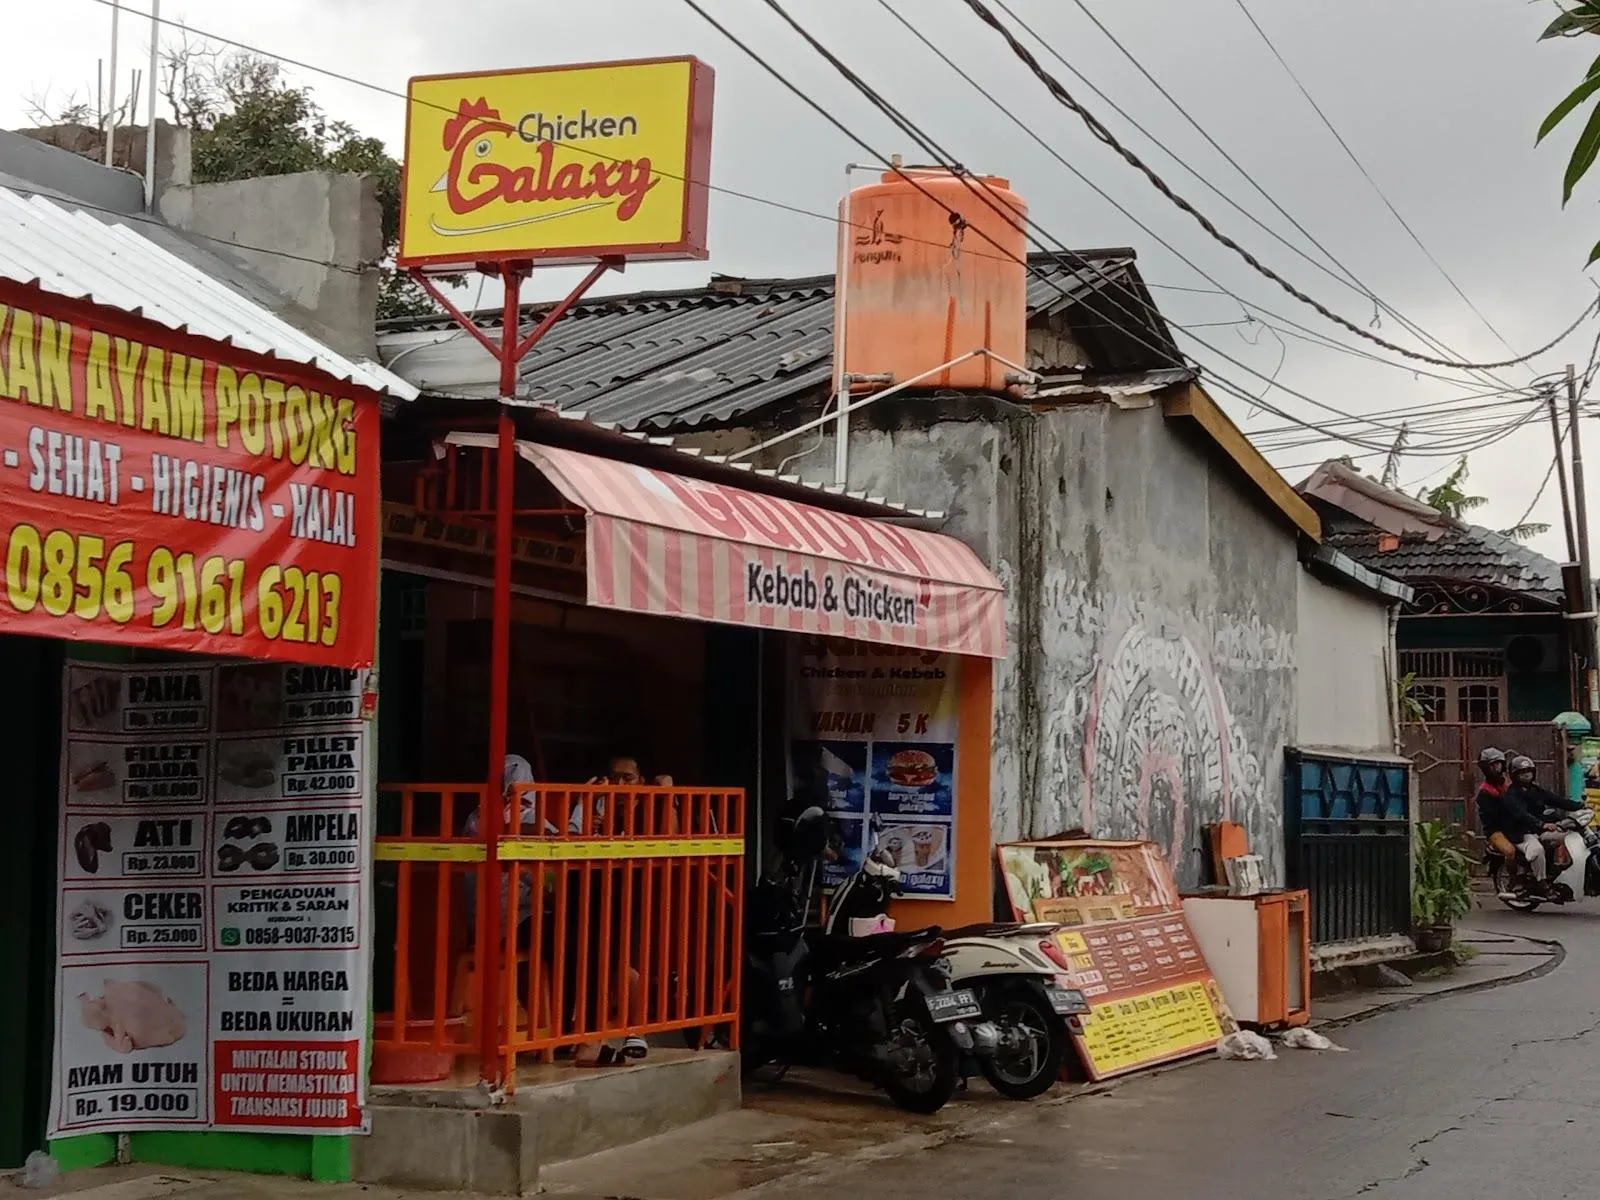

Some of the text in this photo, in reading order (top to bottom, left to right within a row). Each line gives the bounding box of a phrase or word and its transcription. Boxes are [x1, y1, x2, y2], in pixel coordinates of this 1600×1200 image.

[518, 109, 637, 143] Chicken
[446, 121, 661, 221] Galaxy
[86, 330, 205, 442] AYAM
[216, 365, 356, 475] POTONG
[28, 426, 121, 505] SEHAT
[152, 453, 265, 531] HIGIENIS
[289, 483, 356, 546] HALAL
[6, 523, 341, 646] 0856 9161 6213
[747, 562, 916, 625] Kebab & Chicken
[286, 666, 358, 695] SAYAP
[801, 666, 866, 680] Chicken
[890, 667, 946, 680] Kebab
[129, 676, 201, 703] PAHA
[897, 713, 910, 733] 5
[915, 713, 929, 734] K
[125, 745, 203, 761] FILLET
[284, 736, 359, 754] FILLET
[288, 753, 354, 771] PAHA
[309, 774, 355, 790] 42.000
[133, 819, 193, 847] ATI
[285, 813, 358, 842] AMPELA
[309, 850, 355, 865] 30.000
[240, 887, 336, 900] PENGADUAN
[124, 892, 202, 920] CEKER
[227, 899, 349, 913] KRITIK & SARAN
[126, 925, 197, 943] Rp. 25.000
[245, 926, 354, 945] 0858-9037-3315
[228, 970, 349, 992] BEDA HARGA
[221, 1010, 353, 1032] BEDA UKURAN
[232, 1050, 348, 1070] MINTALAH STRUK
[68, 1062, 198, 1089] AYAM UTUH
[221, 1073, 265, 1093] UNTUK
[75, 1093, 189, 1116] Rp. 19.000
[230, 1097, 348, 1119] TRANSAKSI JUJUR
